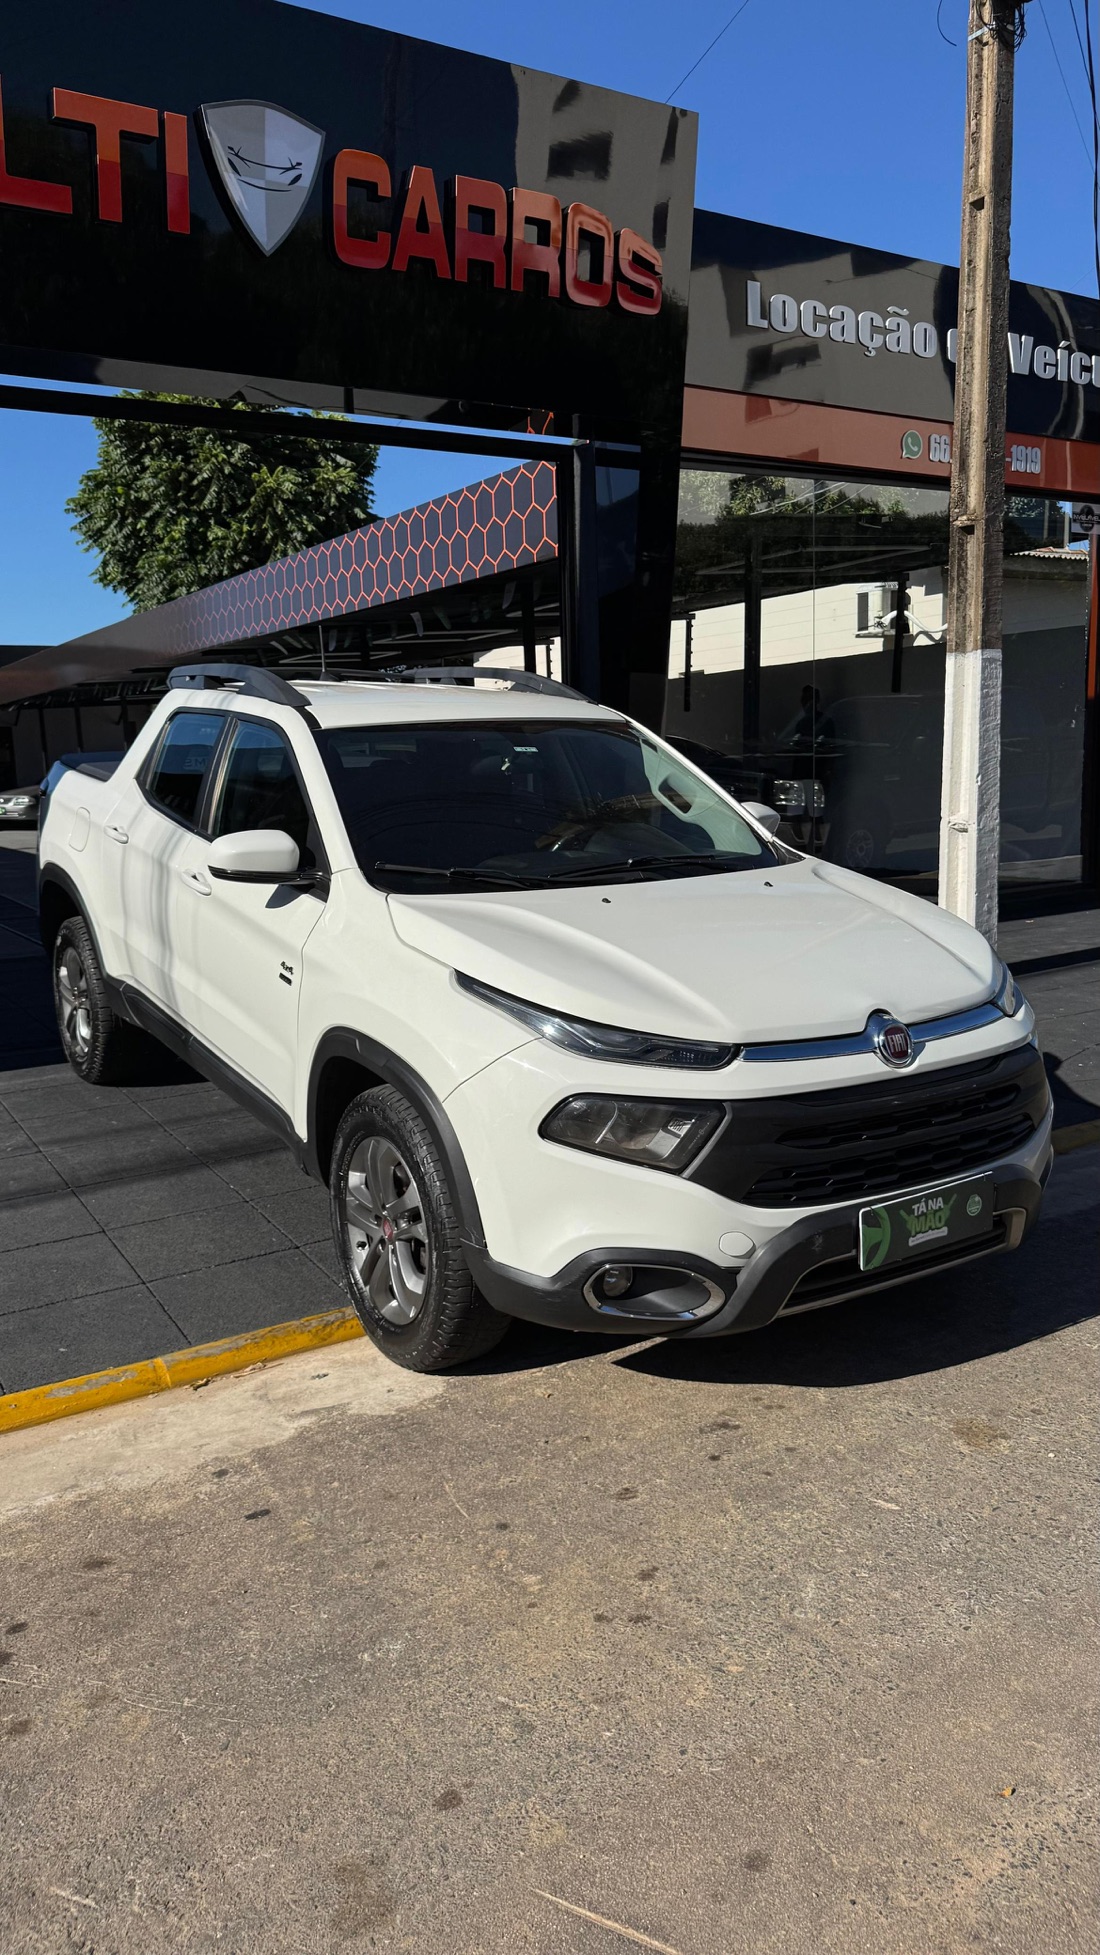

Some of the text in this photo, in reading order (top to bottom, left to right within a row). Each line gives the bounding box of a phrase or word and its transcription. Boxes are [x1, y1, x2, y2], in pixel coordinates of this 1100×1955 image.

[333, 148, 663, 316] CARROS
[746, 280, 938, 358] Locação
[887, 1033, 907, 1053] FIAT
[911, 1196, 944, 1216] TÁ NA
